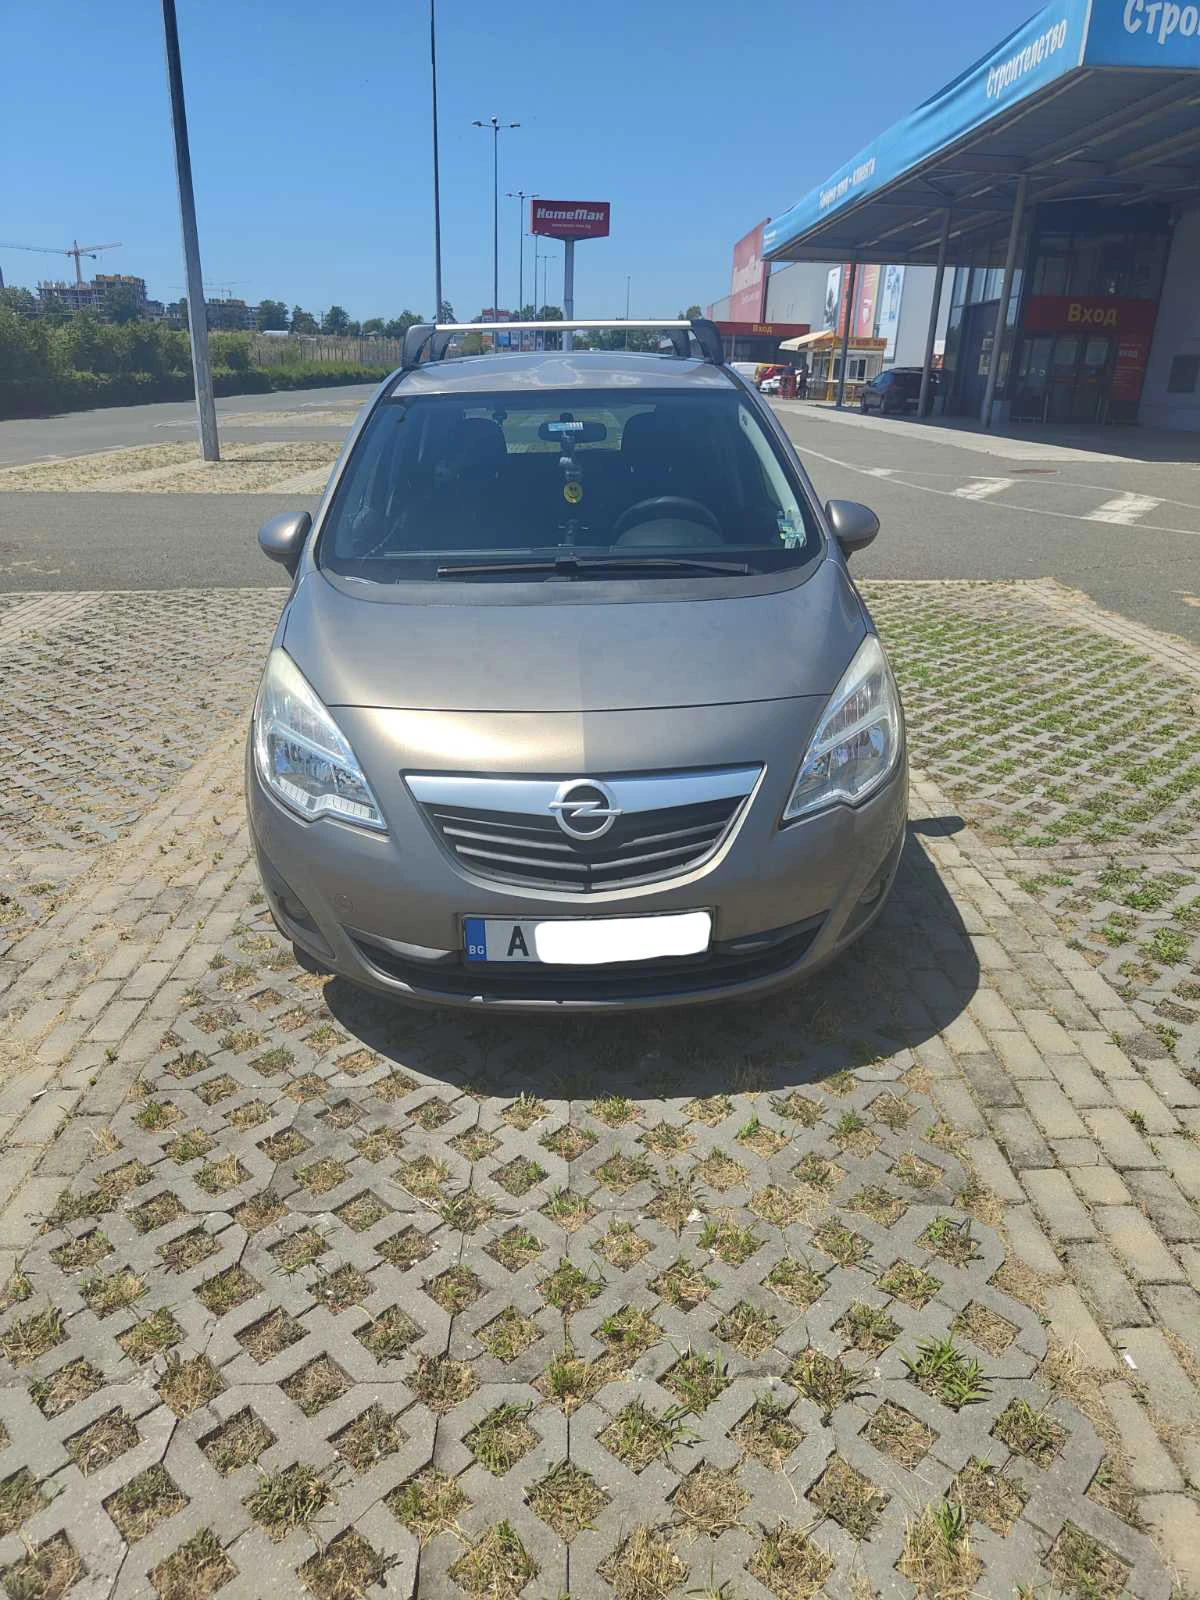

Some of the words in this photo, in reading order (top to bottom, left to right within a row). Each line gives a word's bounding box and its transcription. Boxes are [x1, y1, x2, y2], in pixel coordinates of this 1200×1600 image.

[1123, 0, 1200, 45] Стро
[986, 18, 1067, 99] Строителство
[1067, 303, 1118, 327] Вход
[752, 324, 773, 336] Вход
[469, 945, 485, 955] BG
